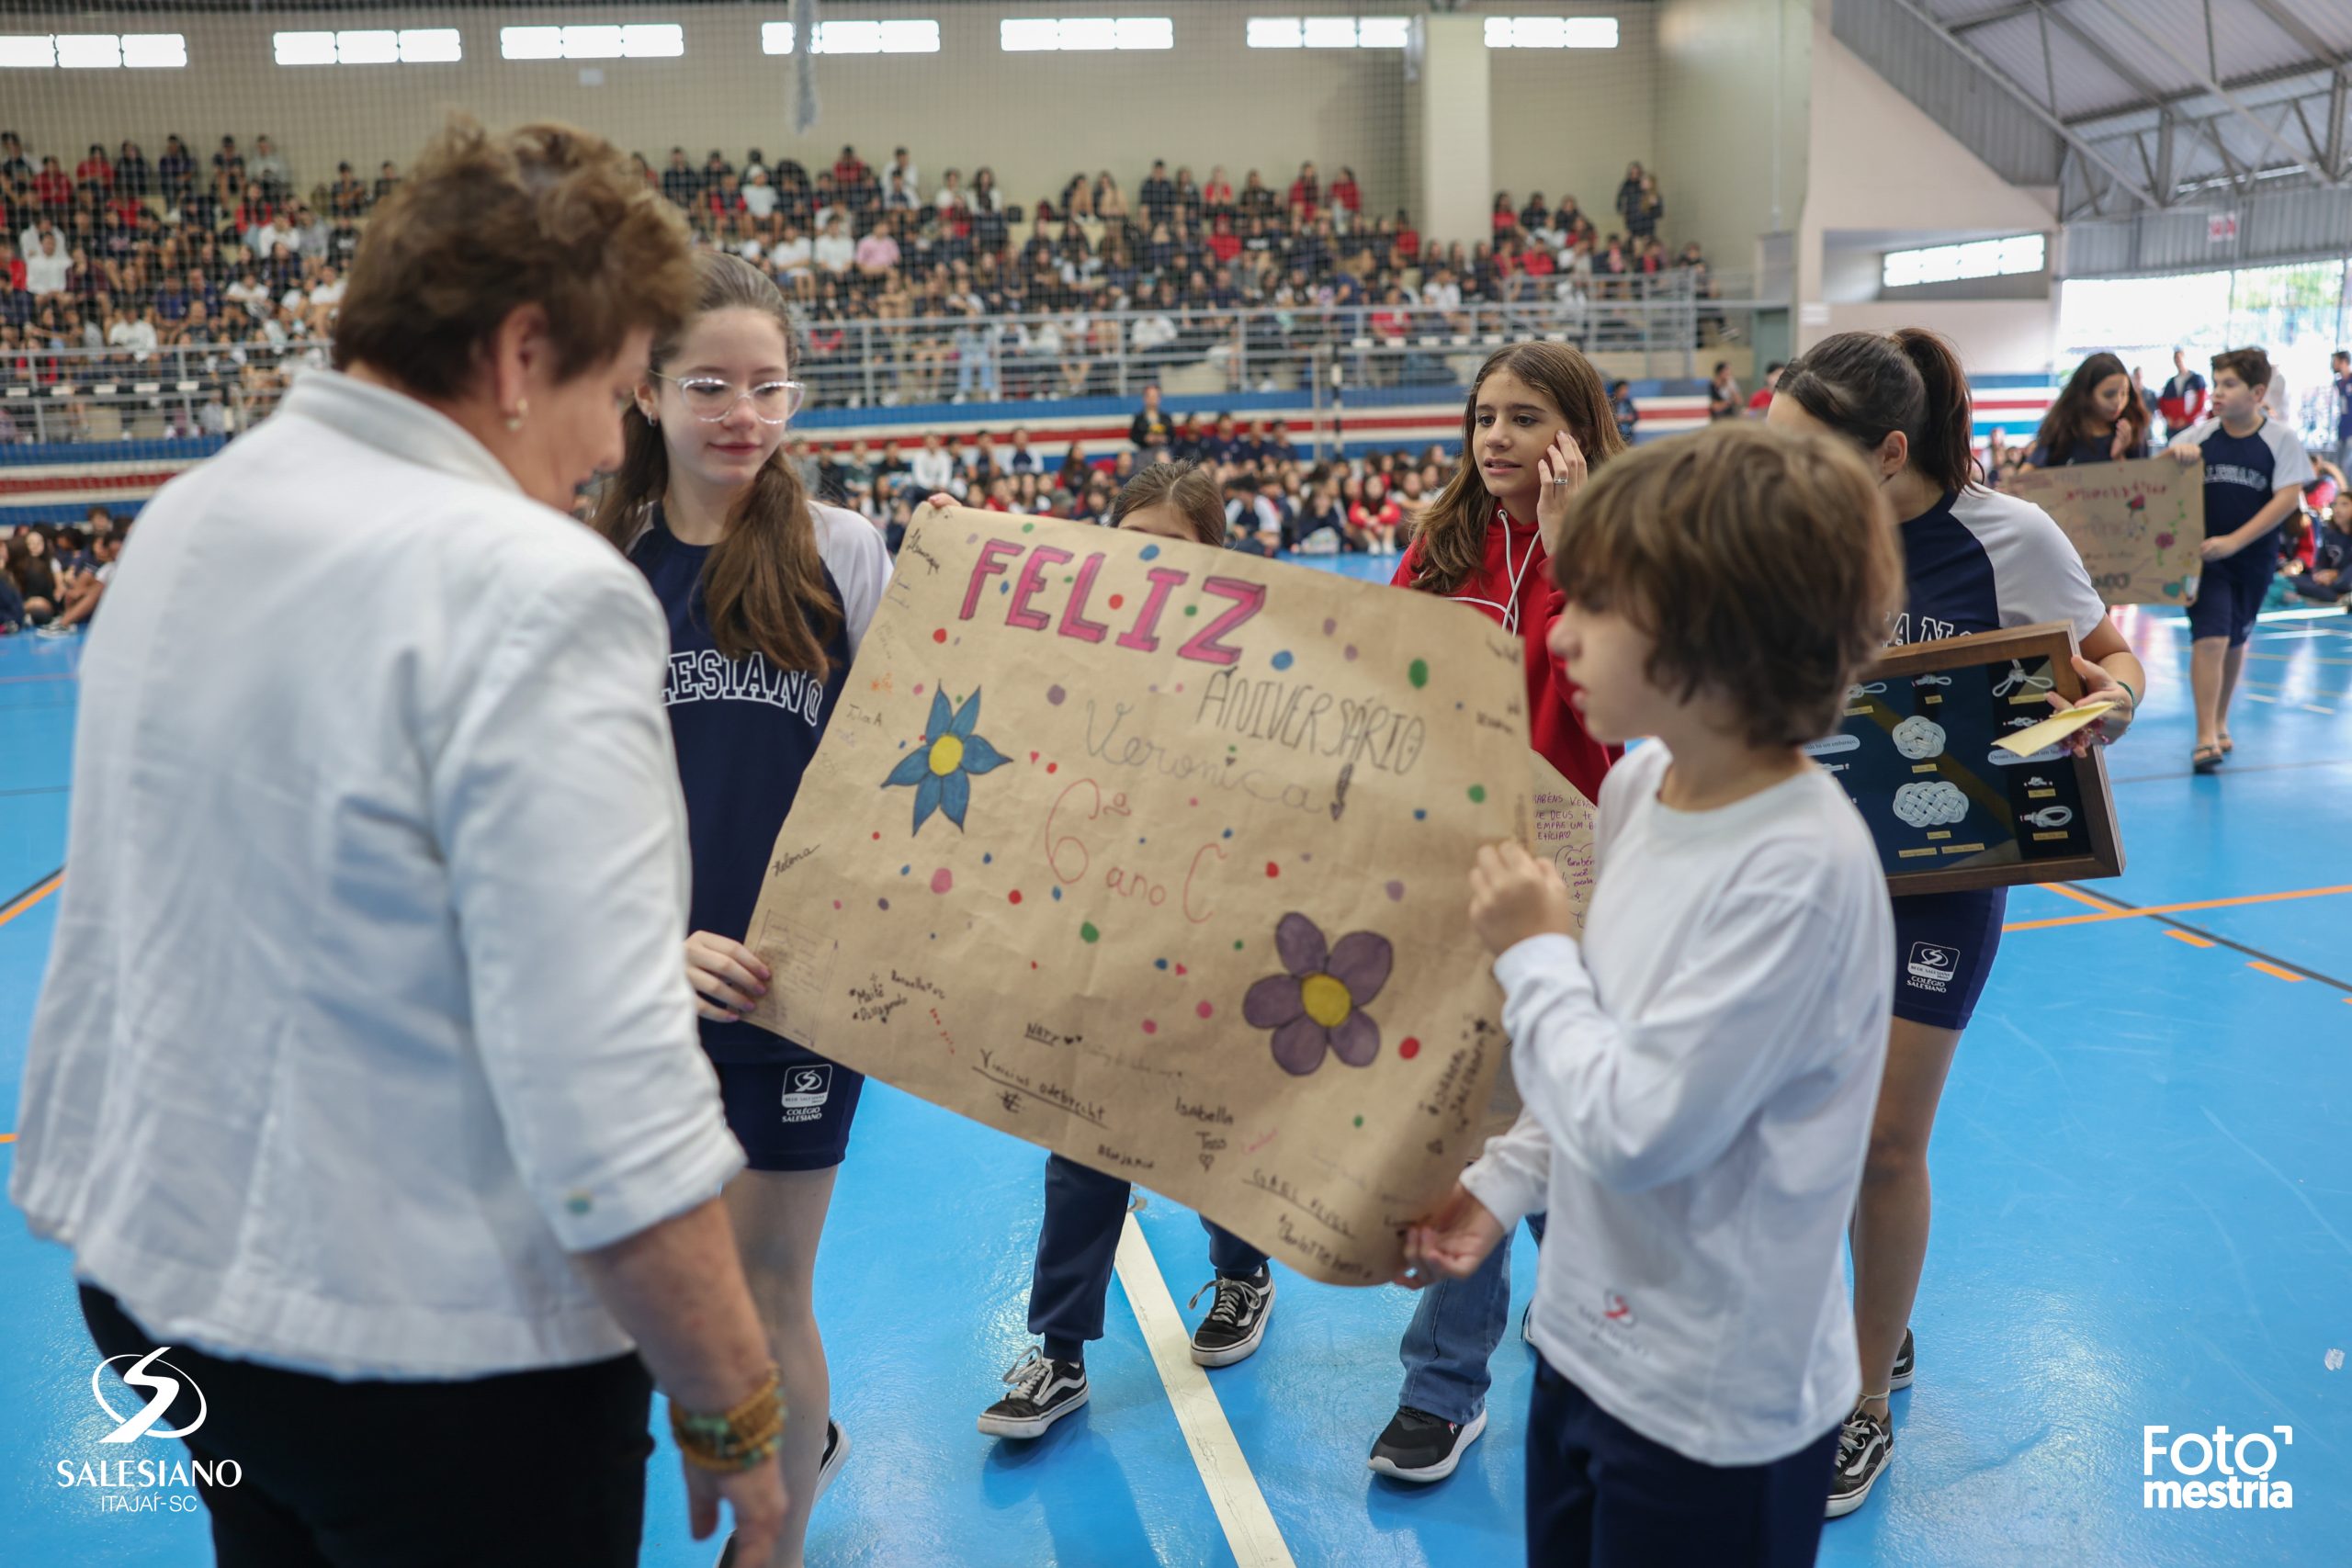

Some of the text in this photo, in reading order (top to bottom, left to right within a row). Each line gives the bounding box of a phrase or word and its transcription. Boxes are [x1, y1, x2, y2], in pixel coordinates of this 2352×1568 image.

[959, 538, 1267, 666] FELIZ
[1550, 809, 1574, 820] DEUS
[1569, 821, 1583, 829] UM
[1105, 867, 1167, 906] ano
[1182, 843, 1228, 924] C
[1906, 979, 1947, 993] SALESIANO
[1911, 976, 1945, 987] COLÉGIO
[786, 1106, 820, 1115] COLÉGIO
[1175, 1097, 1234, 1126] Isabella
[782, 1112, 822, 1122] SALESIANO
